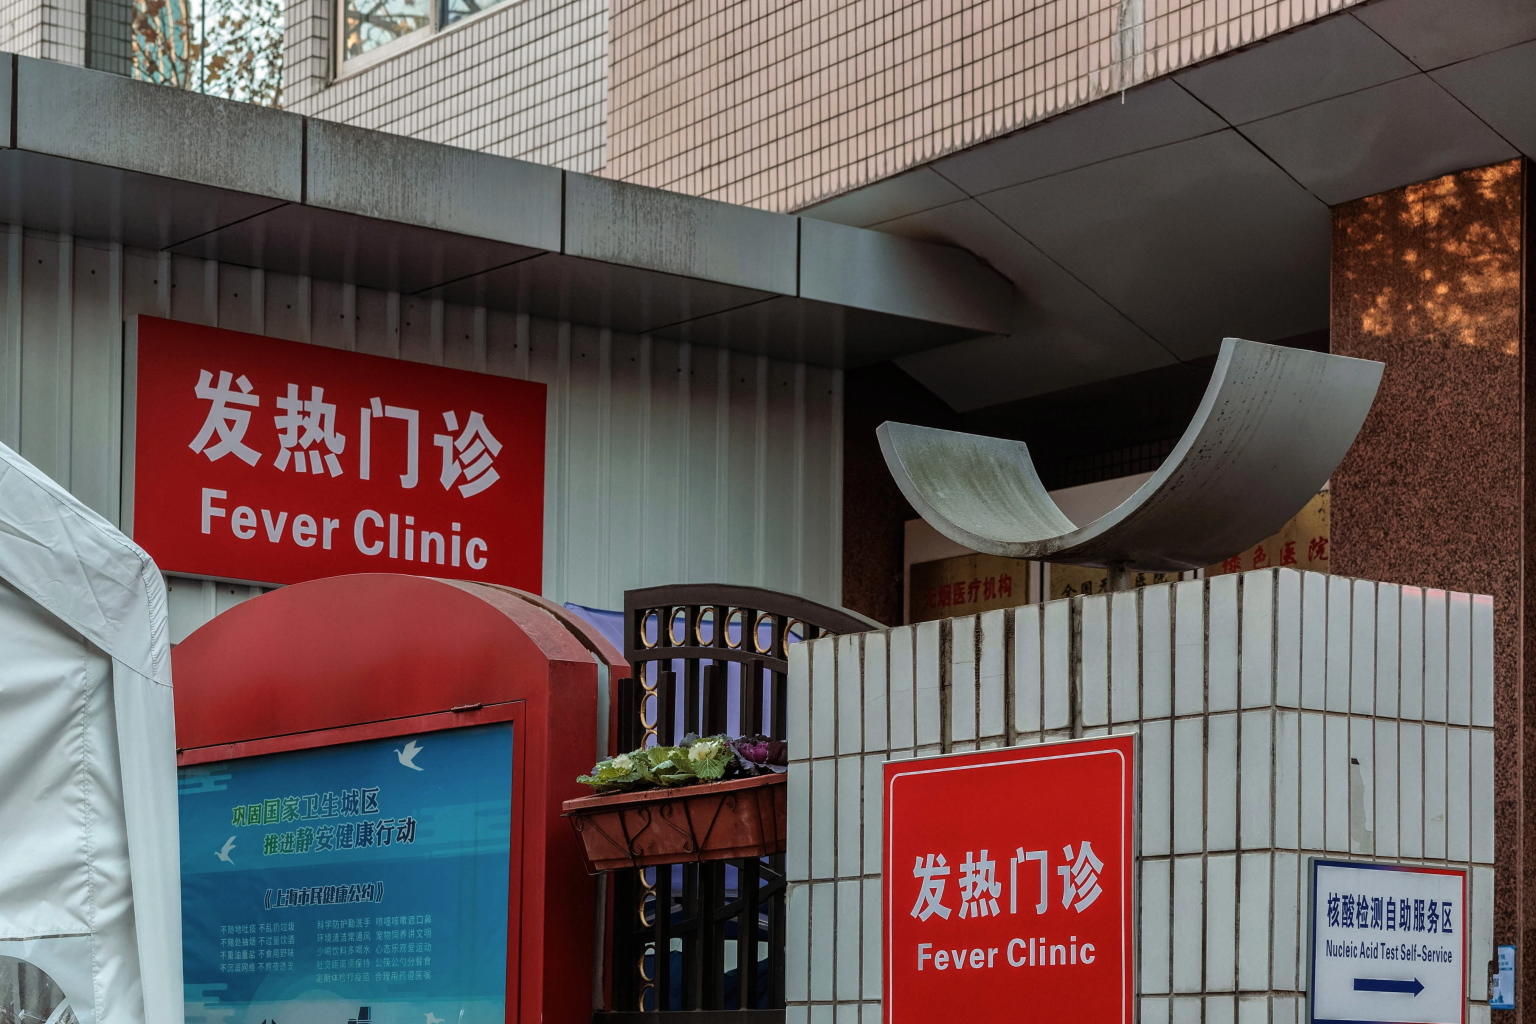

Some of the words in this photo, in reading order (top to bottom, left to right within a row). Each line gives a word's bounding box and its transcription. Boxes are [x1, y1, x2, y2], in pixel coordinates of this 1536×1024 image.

[188, 368, 504, 499] 发热门诊
[200, 487, 340, 551] Fever
[353, 509, 489, 571] Clinic
[232, 786, 381, 827] 巩固国家卫生城区
[263, 816, 417, 856] 推进静安健康行动
[264, 881, 385, 910] 《上海市民健康公约》
[910, 840, 1105, 921] 发热门诊
[1327, 891, 1454, 934] 核酸检测自助服务区
[917, 943, 998, 972] Fever
[1006, 936, 1096, 968] Clinic
[1326, 939, 1358, 958] Nucleic
[1359, 941, 1378, 960] Acid
[1380, 942, 1399, 961] Test
[1400, 943, 1453, 964] Self-Service
